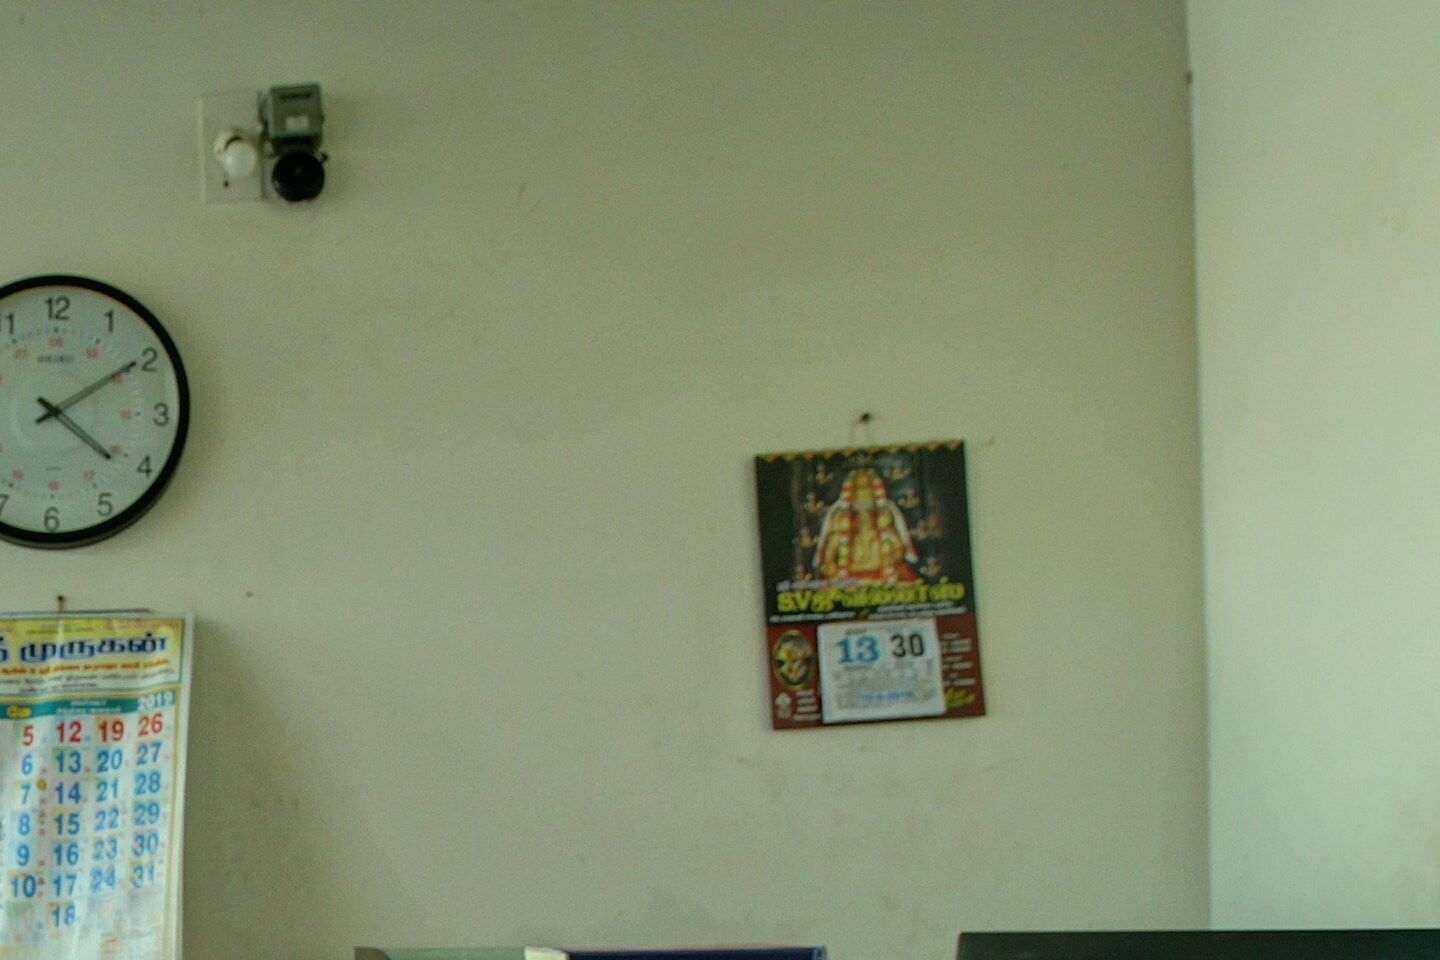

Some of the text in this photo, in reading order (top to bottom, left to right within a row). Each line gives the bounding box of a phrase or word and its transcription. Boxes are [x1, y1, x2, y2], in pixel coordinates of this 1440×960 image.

[45, 297, 71, 320] 12
[105, 310, 114, 332] 1
[141, 347, 158, 373] 2
[153, 403, 170, 427] 3
[136, 455, 153, 478] 4
[97, 493, 113, 517] 5
[44, 507, 59, 532] 6
[835, 633, 925, 665] 13 30
[137, 690, 176, 710] 2019
[22, 725, 34, 746] 5
[55, 720, 82, 743] 12
[97, 719, 124, 742] 19
[137, 713, 164, 737] 26
[21, 754, 33, 775] 6
[55, 751, 82, 774] 13
[96, 749, 123, 773] 20
[136, 743, 162, 765] 27
[20, 783, 32, 804] 7
[55, 781, 81, 804] 14
[95, 779, 119, 802] 21
[134, 772, 161, 796] 28
[18, 812, 31, 836] 8
[54, 812, 80, 835] 15
[94, 809, 120, 832] 22
[133, 803, 160, 826] 29
[16, 843, 31, 866] 9
[53, 843, 80, 866] 16
[93, 839, 118, 861] 23
[133, 833, 159, 857] 30
[11, 874, 37, 898] 10
[52, 874, 78, 896] 17
[89, 867, 117, 892] 24
[131, 865, 156, 889] 31
[51, 905, 76, 928] 18
